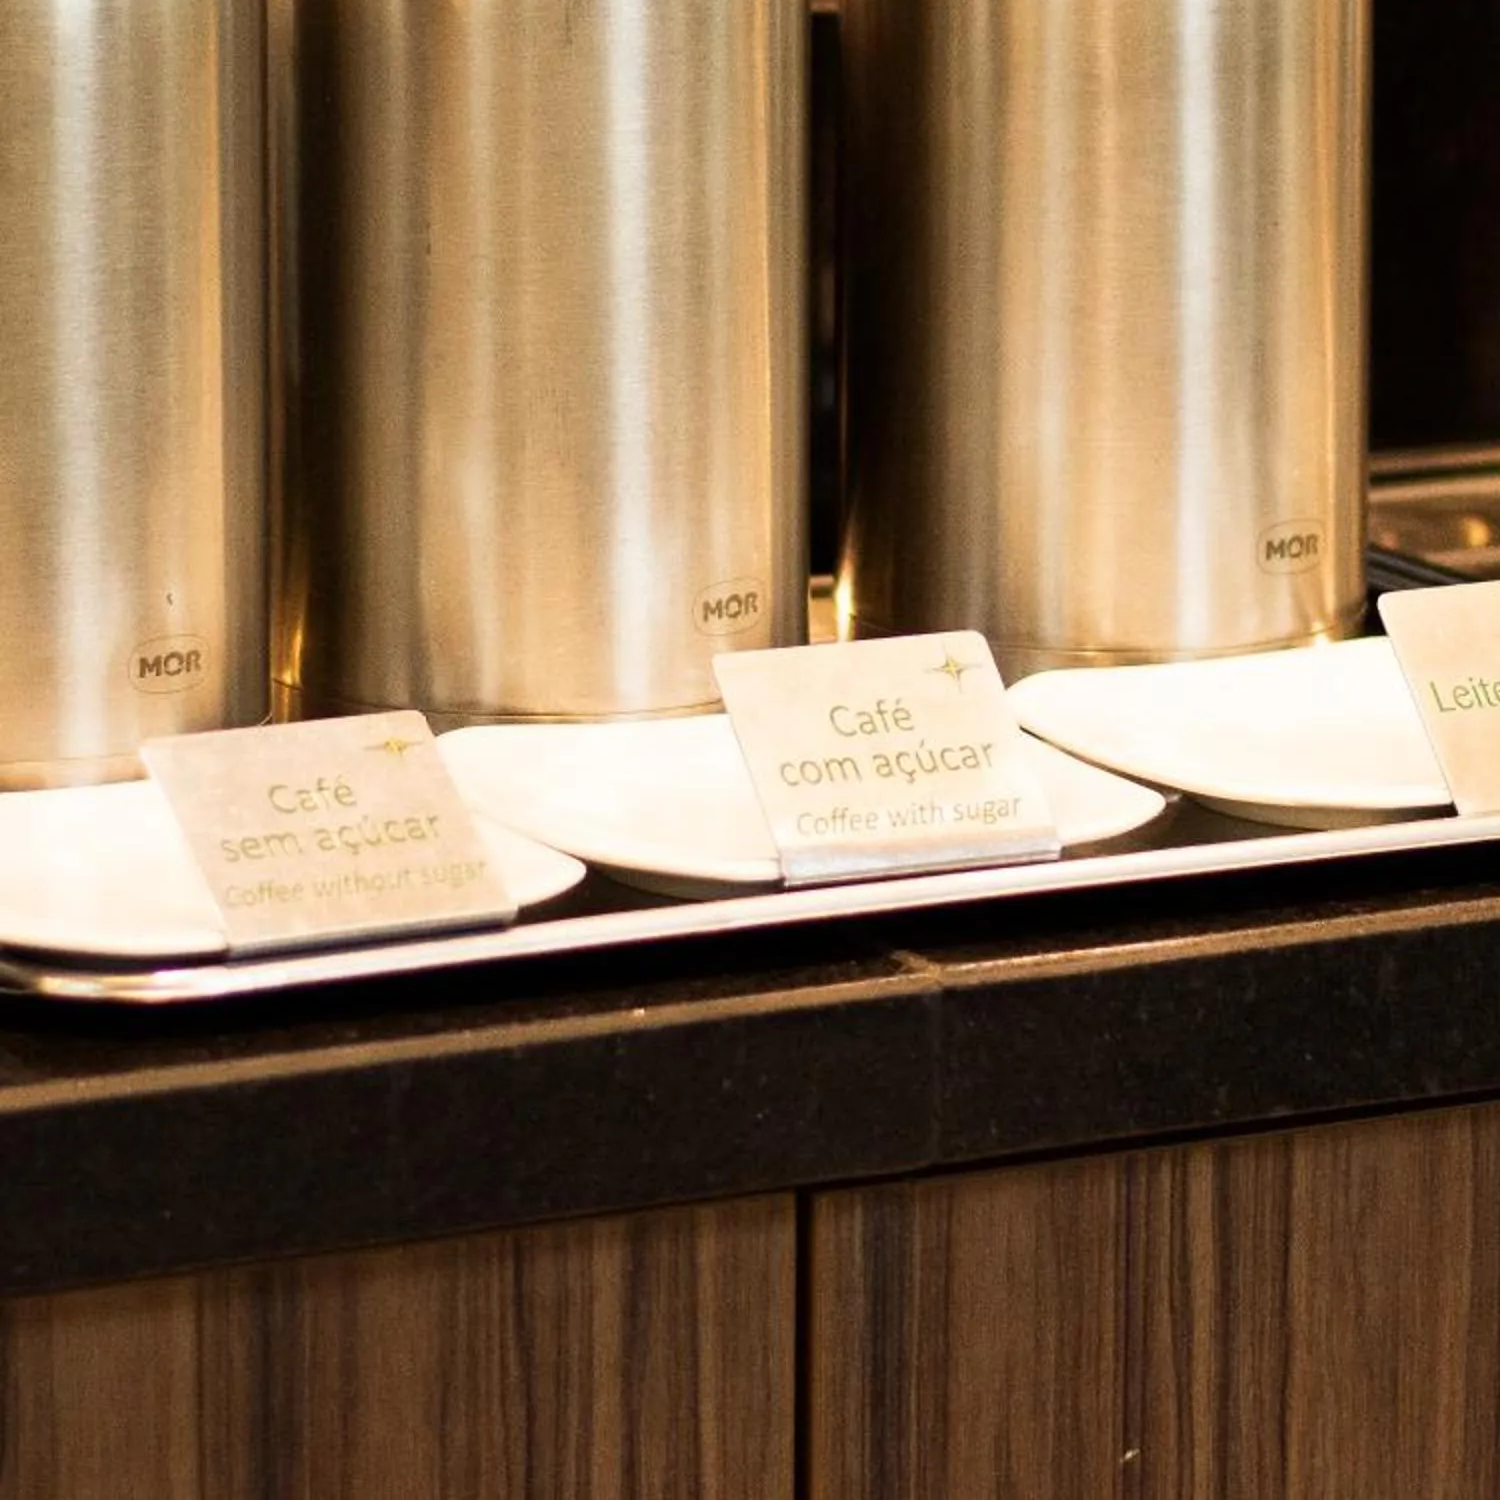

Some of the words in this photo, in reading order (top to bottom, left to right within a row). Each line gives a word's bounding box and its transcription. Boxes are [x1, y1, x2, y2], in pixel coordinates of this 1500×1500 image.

[1265, 533, 1319, 561] MOR
[702, 591, 759, 622] MOR
[139, 649, 202, 678] MOR
[829, 698, 915, 738] Café
[780, 755, 863, 787] com
[871, 739, 995, 785] açúcar
[267, 774, 357, 815] Café
[796, 807, 880, 836] Coffee
[888, 799, 945, 829] with
[953, 795, 1022, 826] sugar
[219, 830, 302, 863] sem
[316, 812, 441, 856] açúcar
[224, 878, 302, 909] Coffee
[313, 868, 411, 899] without
[420, 859, 488, 890] sugar
